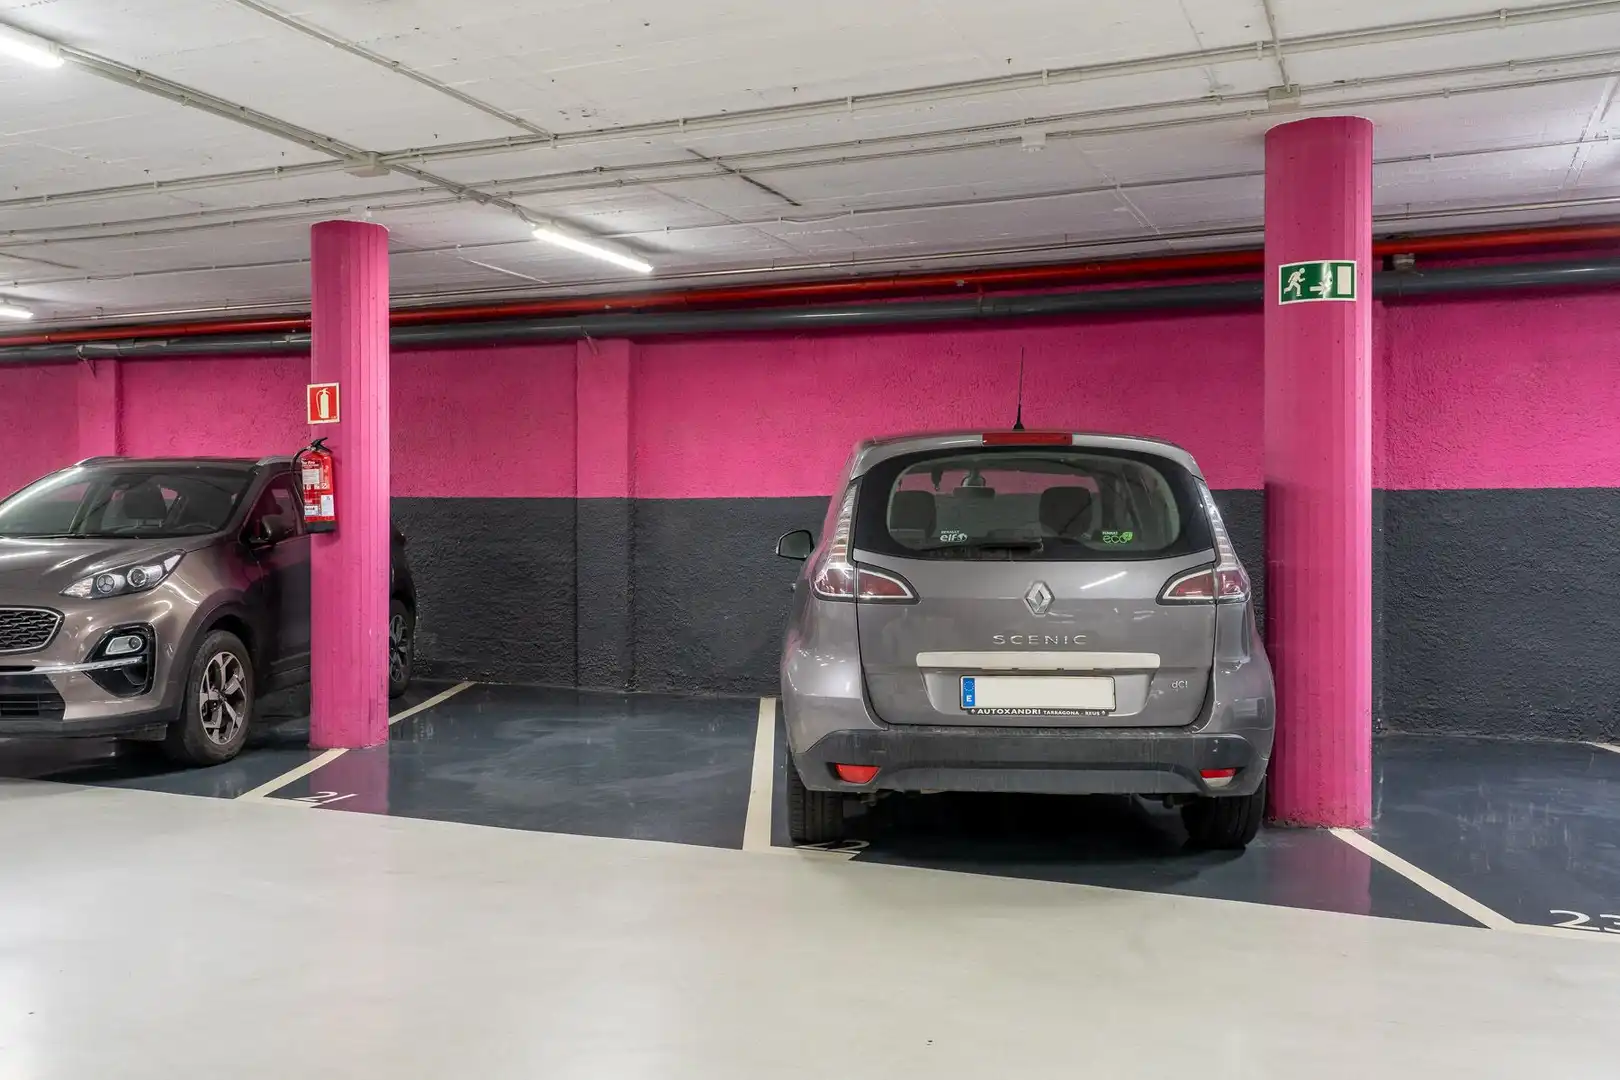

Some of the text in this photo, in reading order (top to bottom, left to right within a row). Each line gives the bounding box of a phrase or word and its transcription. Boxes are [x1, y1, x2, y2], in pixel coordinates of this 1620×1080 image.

[940, 533, 958, 542] elf
[1103, 535, 1127, 544] eco
[993, 634, 1087, 645] SCENIC
